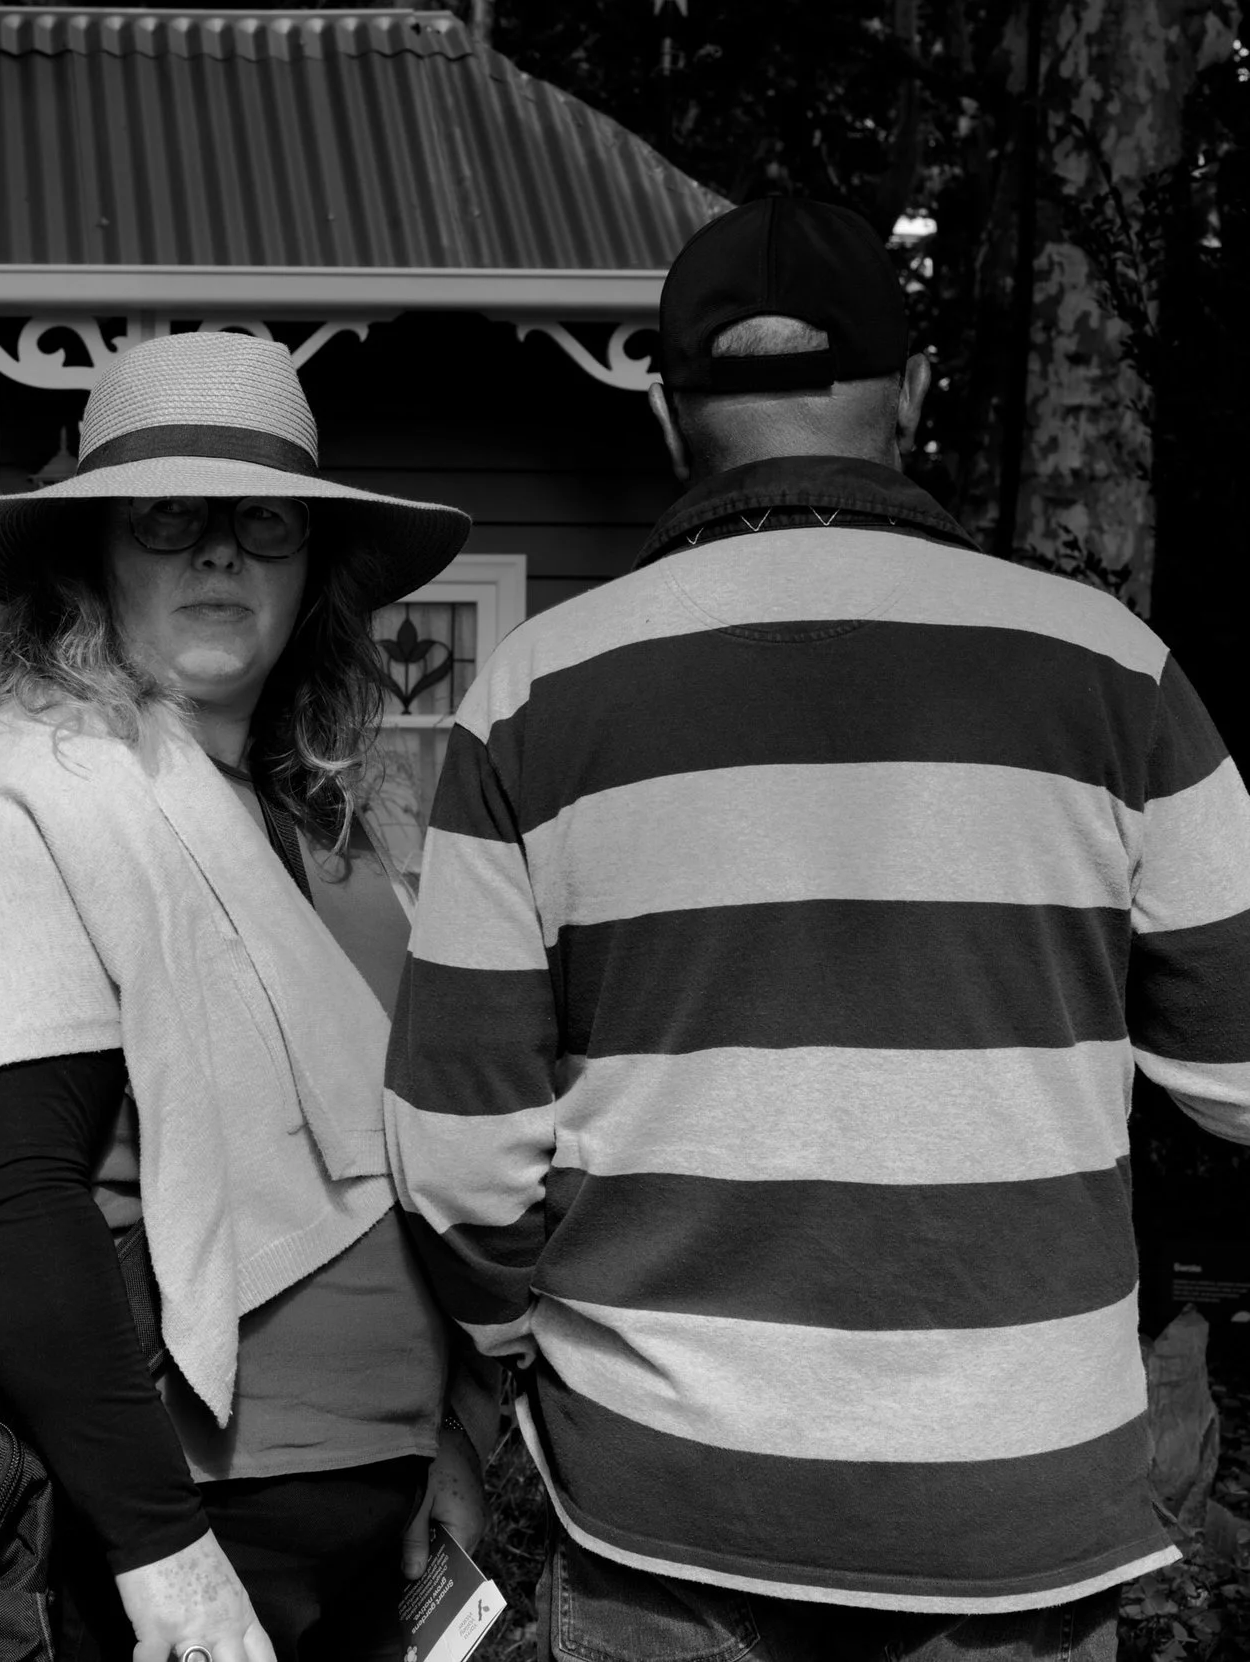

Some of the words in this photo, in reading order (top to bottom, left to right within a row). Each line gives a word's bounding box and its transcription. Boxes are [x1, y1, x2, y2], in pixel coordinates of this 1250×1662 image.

[432, 1576, 447, 1599] grow
[435, 1579, 454, 1605] Smart
[411, 1602, 436, 1634] gardens
